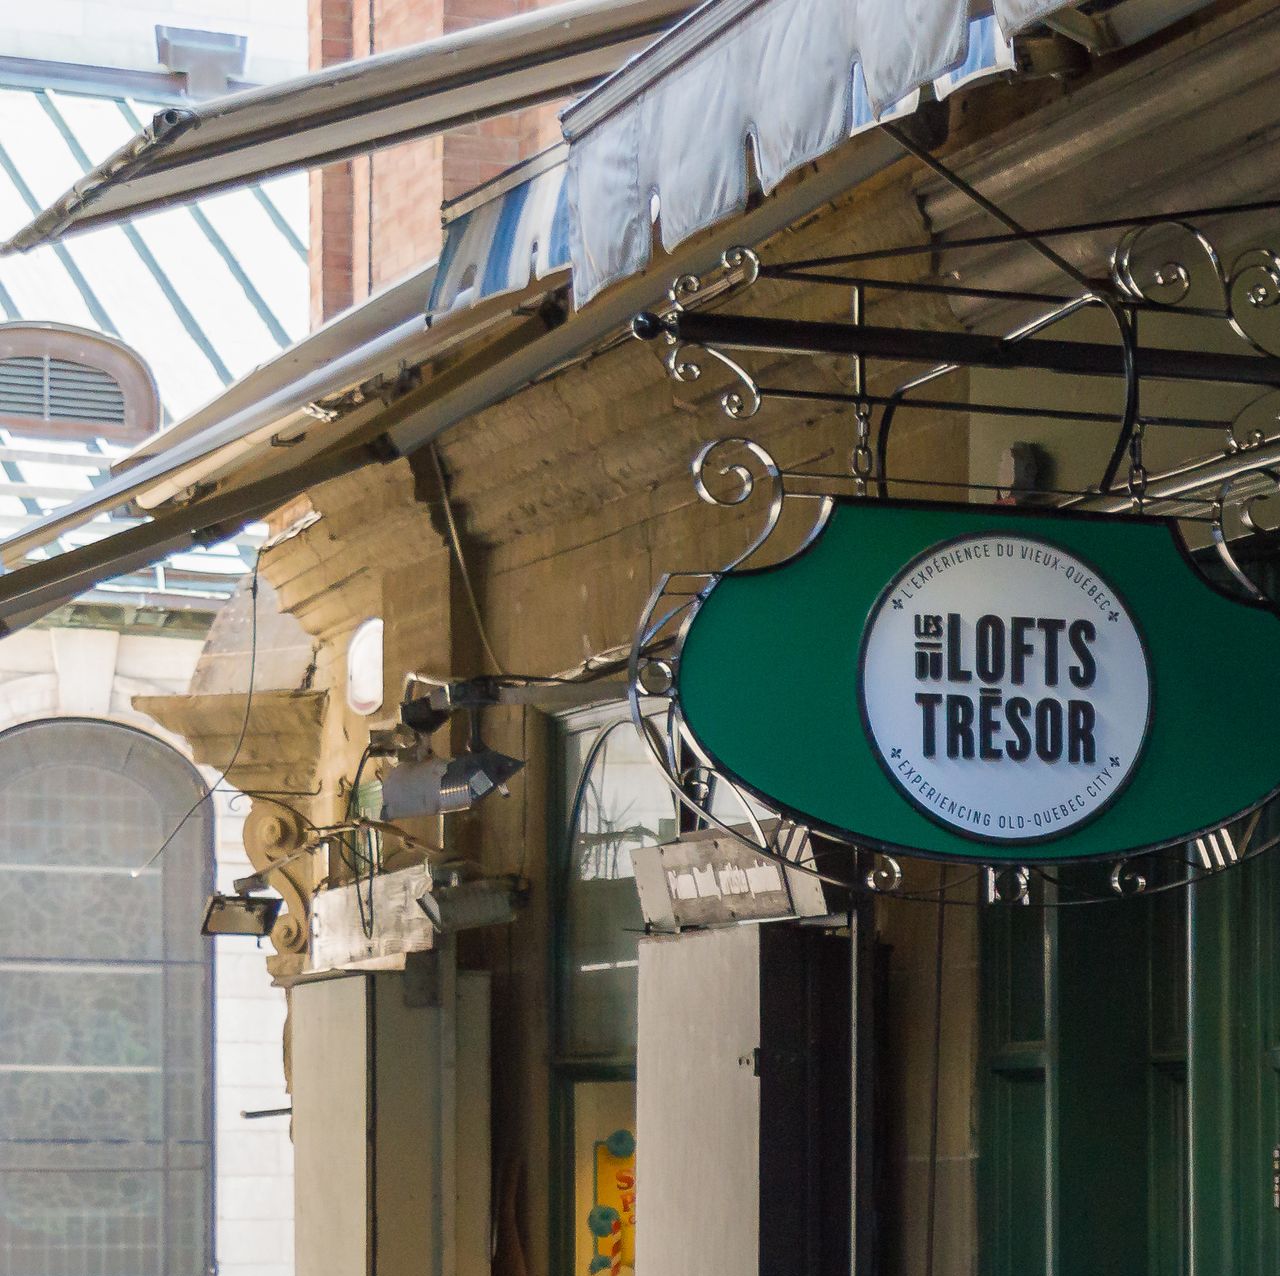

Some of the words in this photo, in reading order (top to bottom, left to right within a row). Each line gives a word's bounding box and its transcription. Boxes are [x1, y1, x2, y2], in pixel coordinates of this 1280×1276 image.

[903, 543, 991, 600] L'EXPÉRIENCE
[996, 543, 1014, 558] DU
[1020, 545, 1112, 612] VIEUX-QUÉBEC
[914, 613, 944, 639] LES
[947, 612, 1098, 690] LOFTS
[914, 650, 944, 682] DU
[914, 687, 1097, 766] TRÉSOR
[898, 759, 991, 827] EXPERIENCING
[998, 794, 1086, 829] OLD-QUEBEC
[1088, 766, 1114, 798] CITY
